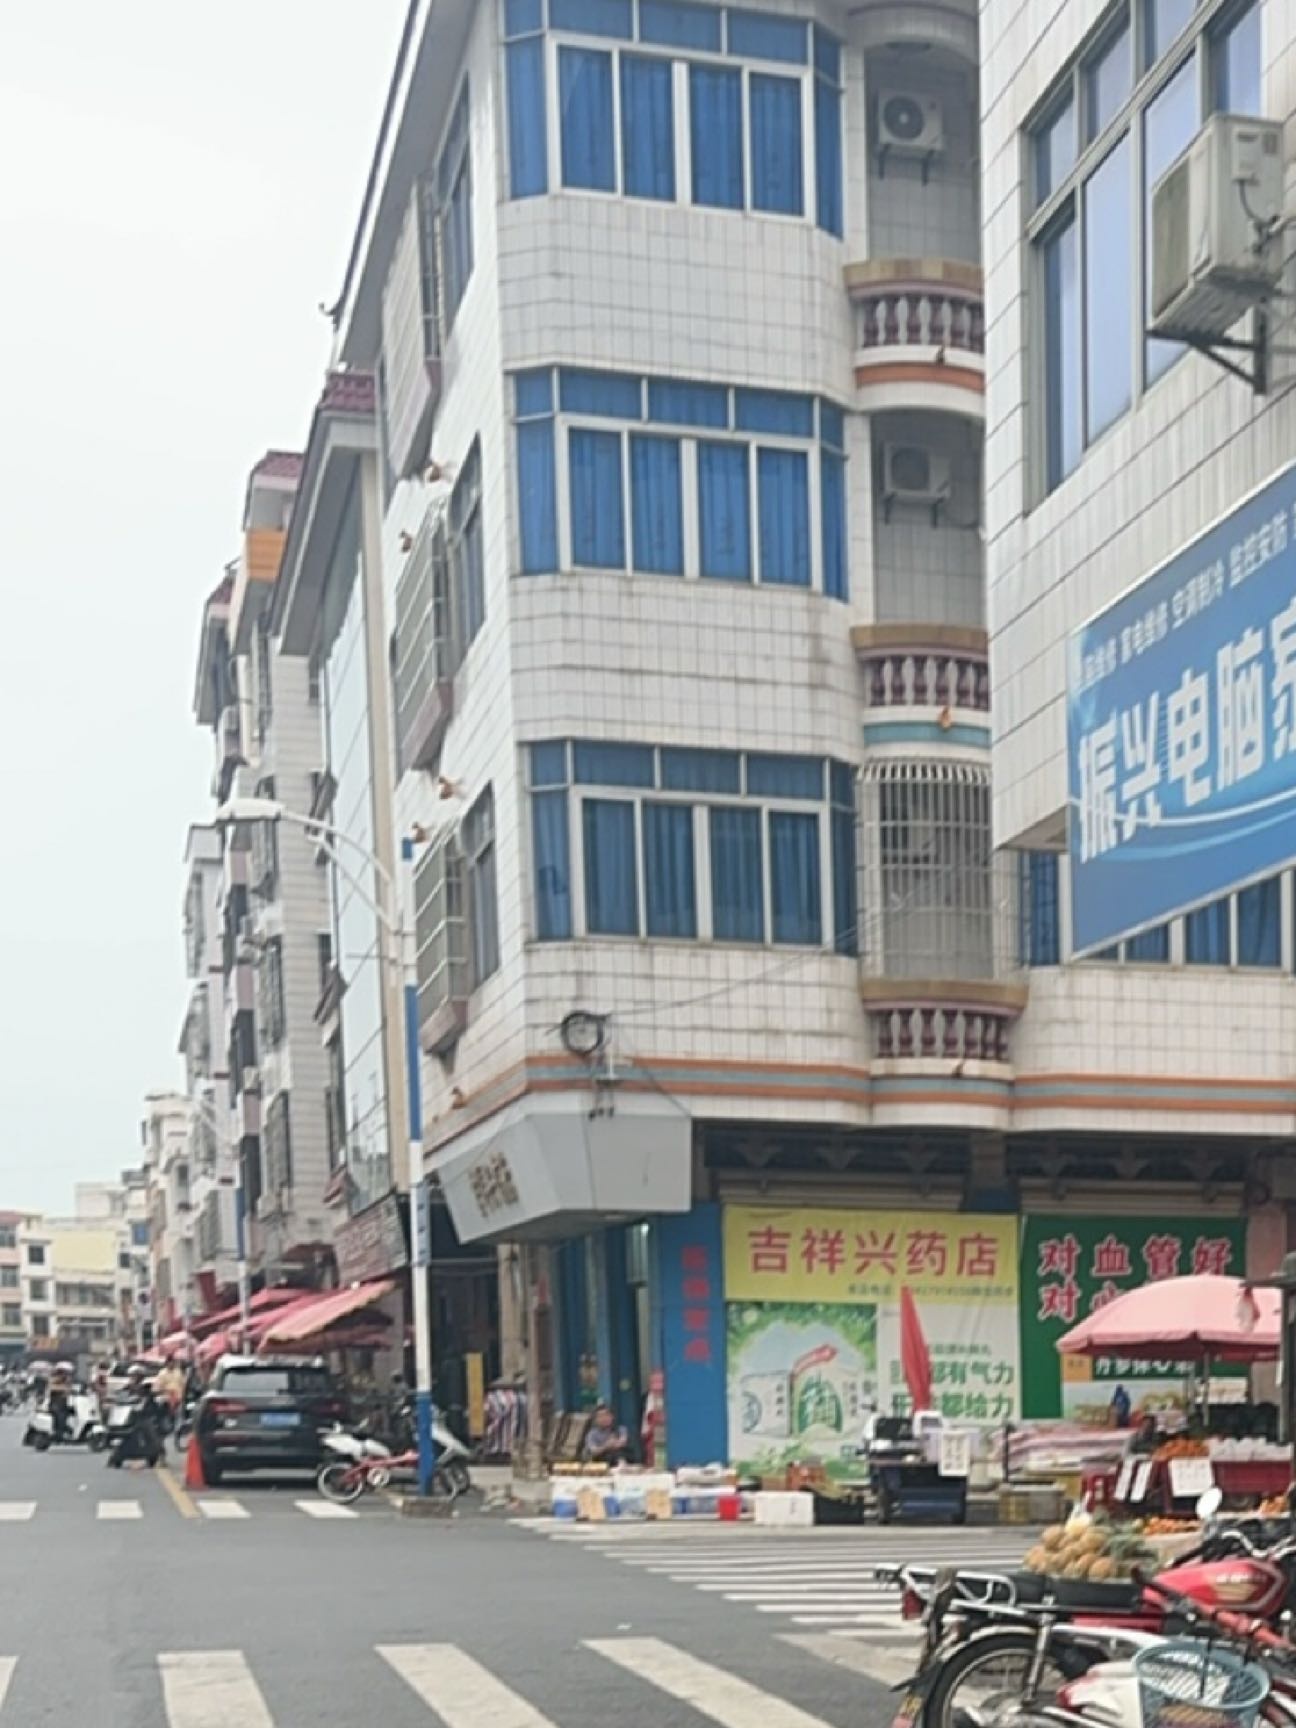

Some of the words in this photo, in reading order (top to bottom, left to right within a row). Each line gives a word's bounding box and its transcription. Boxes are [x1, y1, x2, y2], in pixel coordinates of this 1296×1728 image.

[747, 1226, 998, 1278] 吉祥兴药店
[1038, 1235, 1231, 1277] 对血管好
